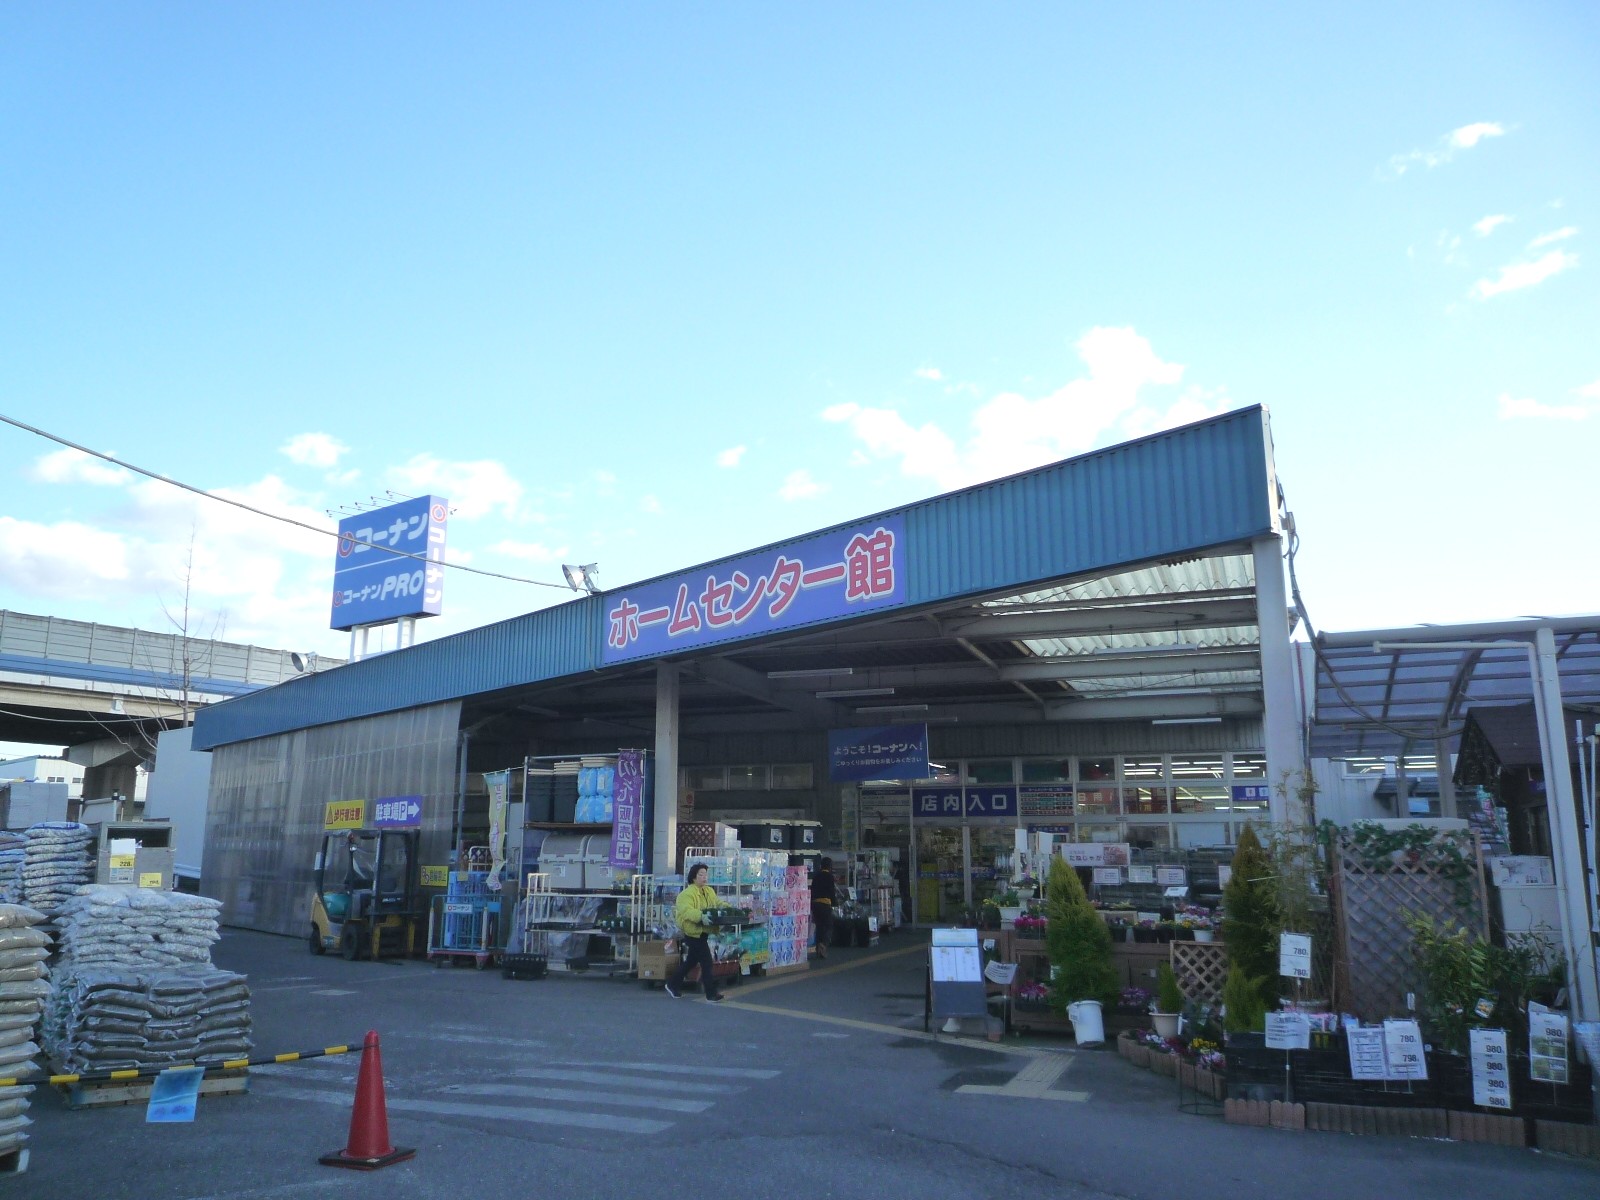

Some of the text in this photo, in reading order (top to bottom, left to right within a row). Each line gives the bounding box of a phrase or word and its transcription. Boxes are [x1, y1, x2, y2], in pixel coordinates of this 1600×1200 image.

[354, 512, 429, 554] コーナン
[425, 527, 446, 604] コーナン
[343, 569, 425, 605] コーナンPRO
[608, 527, 894, 648] ホームセンター館
[920, 793, 1007, 812] 店内入口
[1293, 947, 1307, 956] 780
[1487, 1079, 1505, 1089] 980
